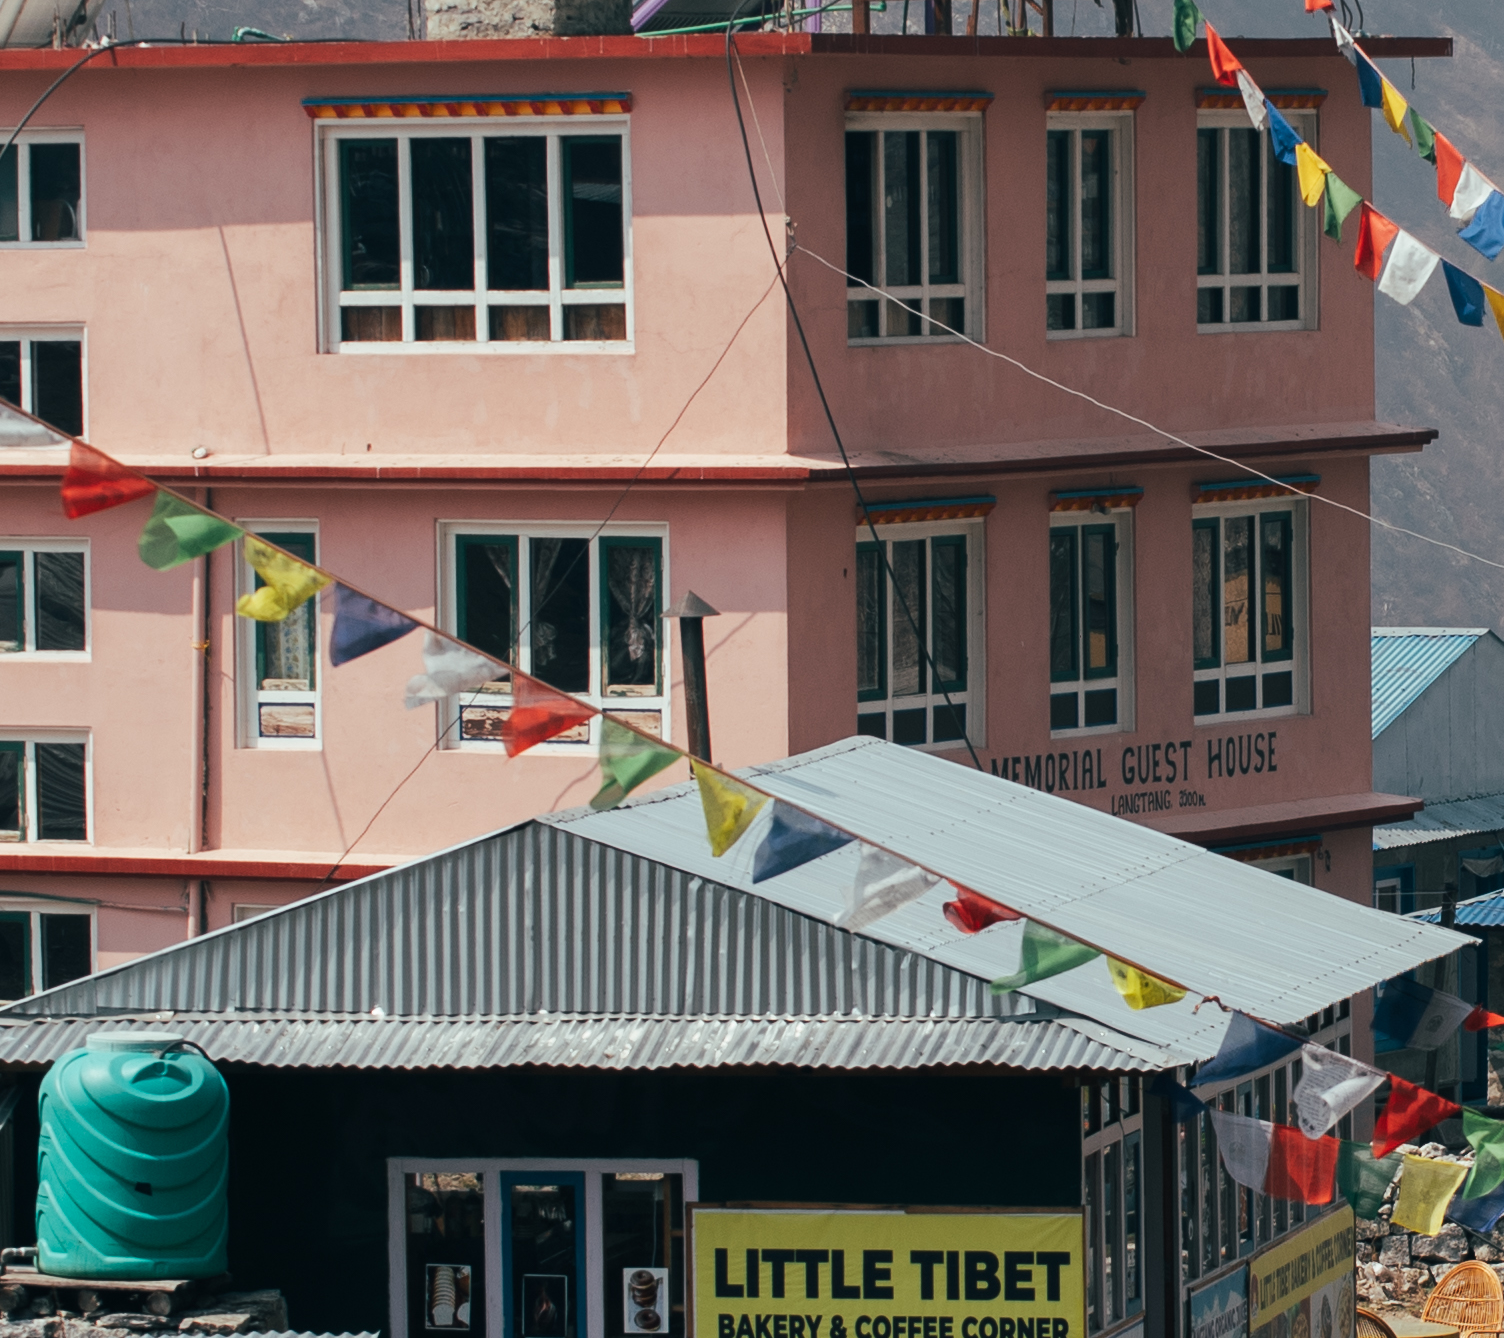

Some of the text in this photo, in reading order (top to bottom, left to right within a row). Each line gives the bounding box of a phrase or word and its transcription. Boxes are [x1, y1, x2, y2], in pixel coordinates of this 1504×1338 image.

[1122, 741, 1192, 784] GUEST
[1208, 732, 1277, 778] HOUSE
[715, 1248, 1071, 1301] LITTLE TIBET
